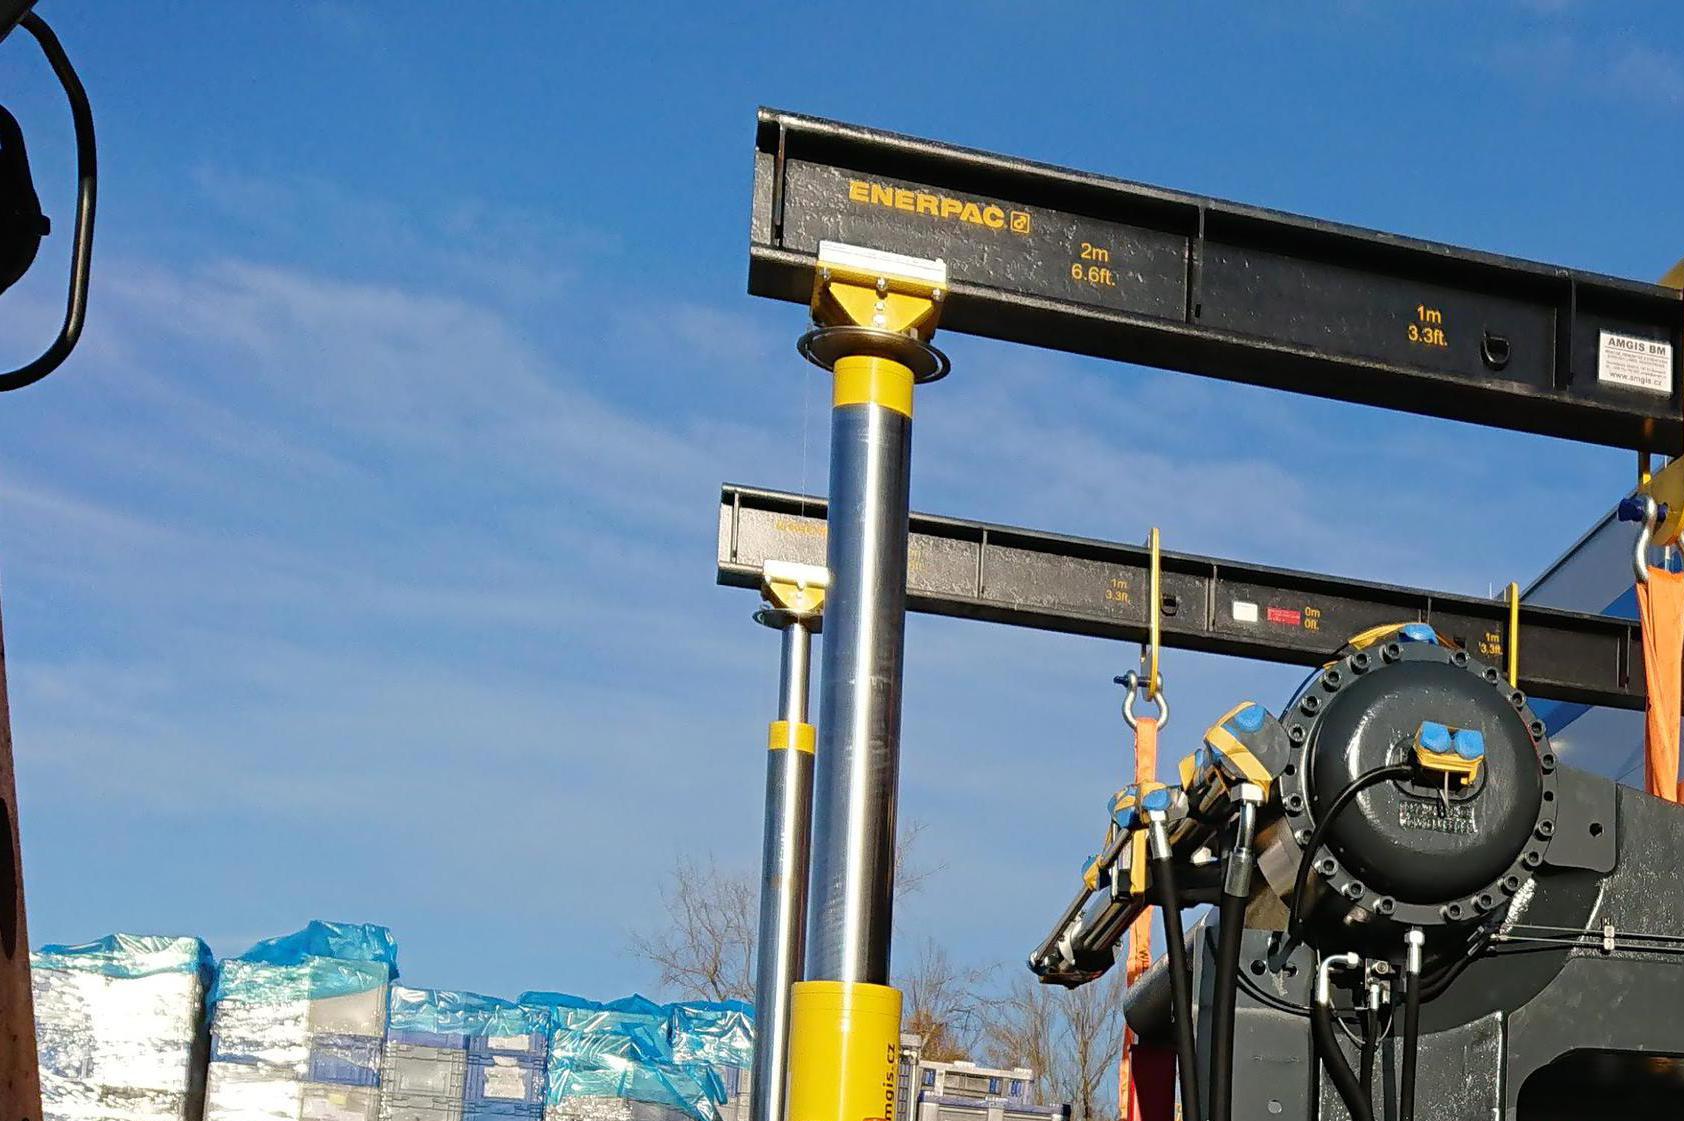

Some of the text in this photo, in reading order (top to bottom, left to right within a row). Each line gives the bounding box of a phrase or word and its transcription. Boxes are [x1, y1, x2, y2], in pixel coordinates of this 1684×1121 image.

[849, 181, 1005, 229] ENERPAC
[1080, 242, 1109, 263] 2m
[1071, 263, 1116, 287] 6.6ft.
[1417, 304, 1442, 325] 1m
[1408, 324, 1448, 347] 3.3ft.
[1608, 337, 1666, 356] AMGIS BM
